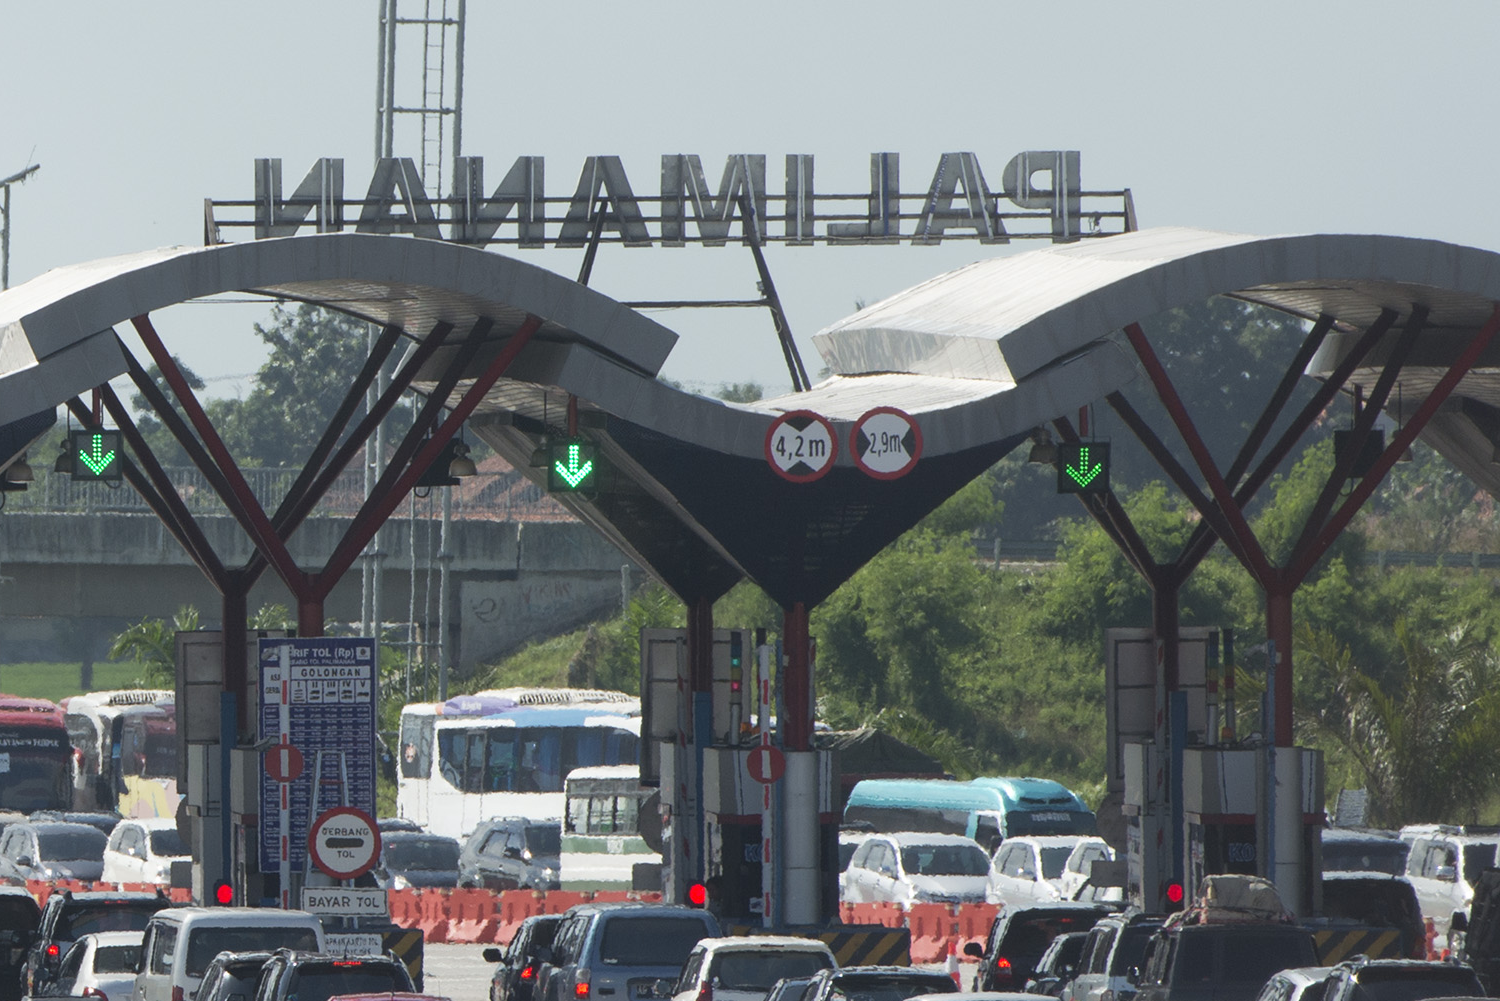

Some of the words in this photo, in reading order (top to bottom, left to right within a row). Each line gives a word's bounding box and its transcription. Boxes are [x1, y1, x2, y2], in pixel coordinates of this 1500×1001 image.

[870, 431, 901, 457] 2,9m
[294, 648, 309, 656] RIF
[313, 648, 332, 656] TOL
[334, 647, 354, 659] (Rp)
[301, 668, 360, 677] GOLONGAN
[337, 850, 355, 858] TOL
[309, 896, 350, 908] BAYAR
[356, 896, 380, 908] TOL
